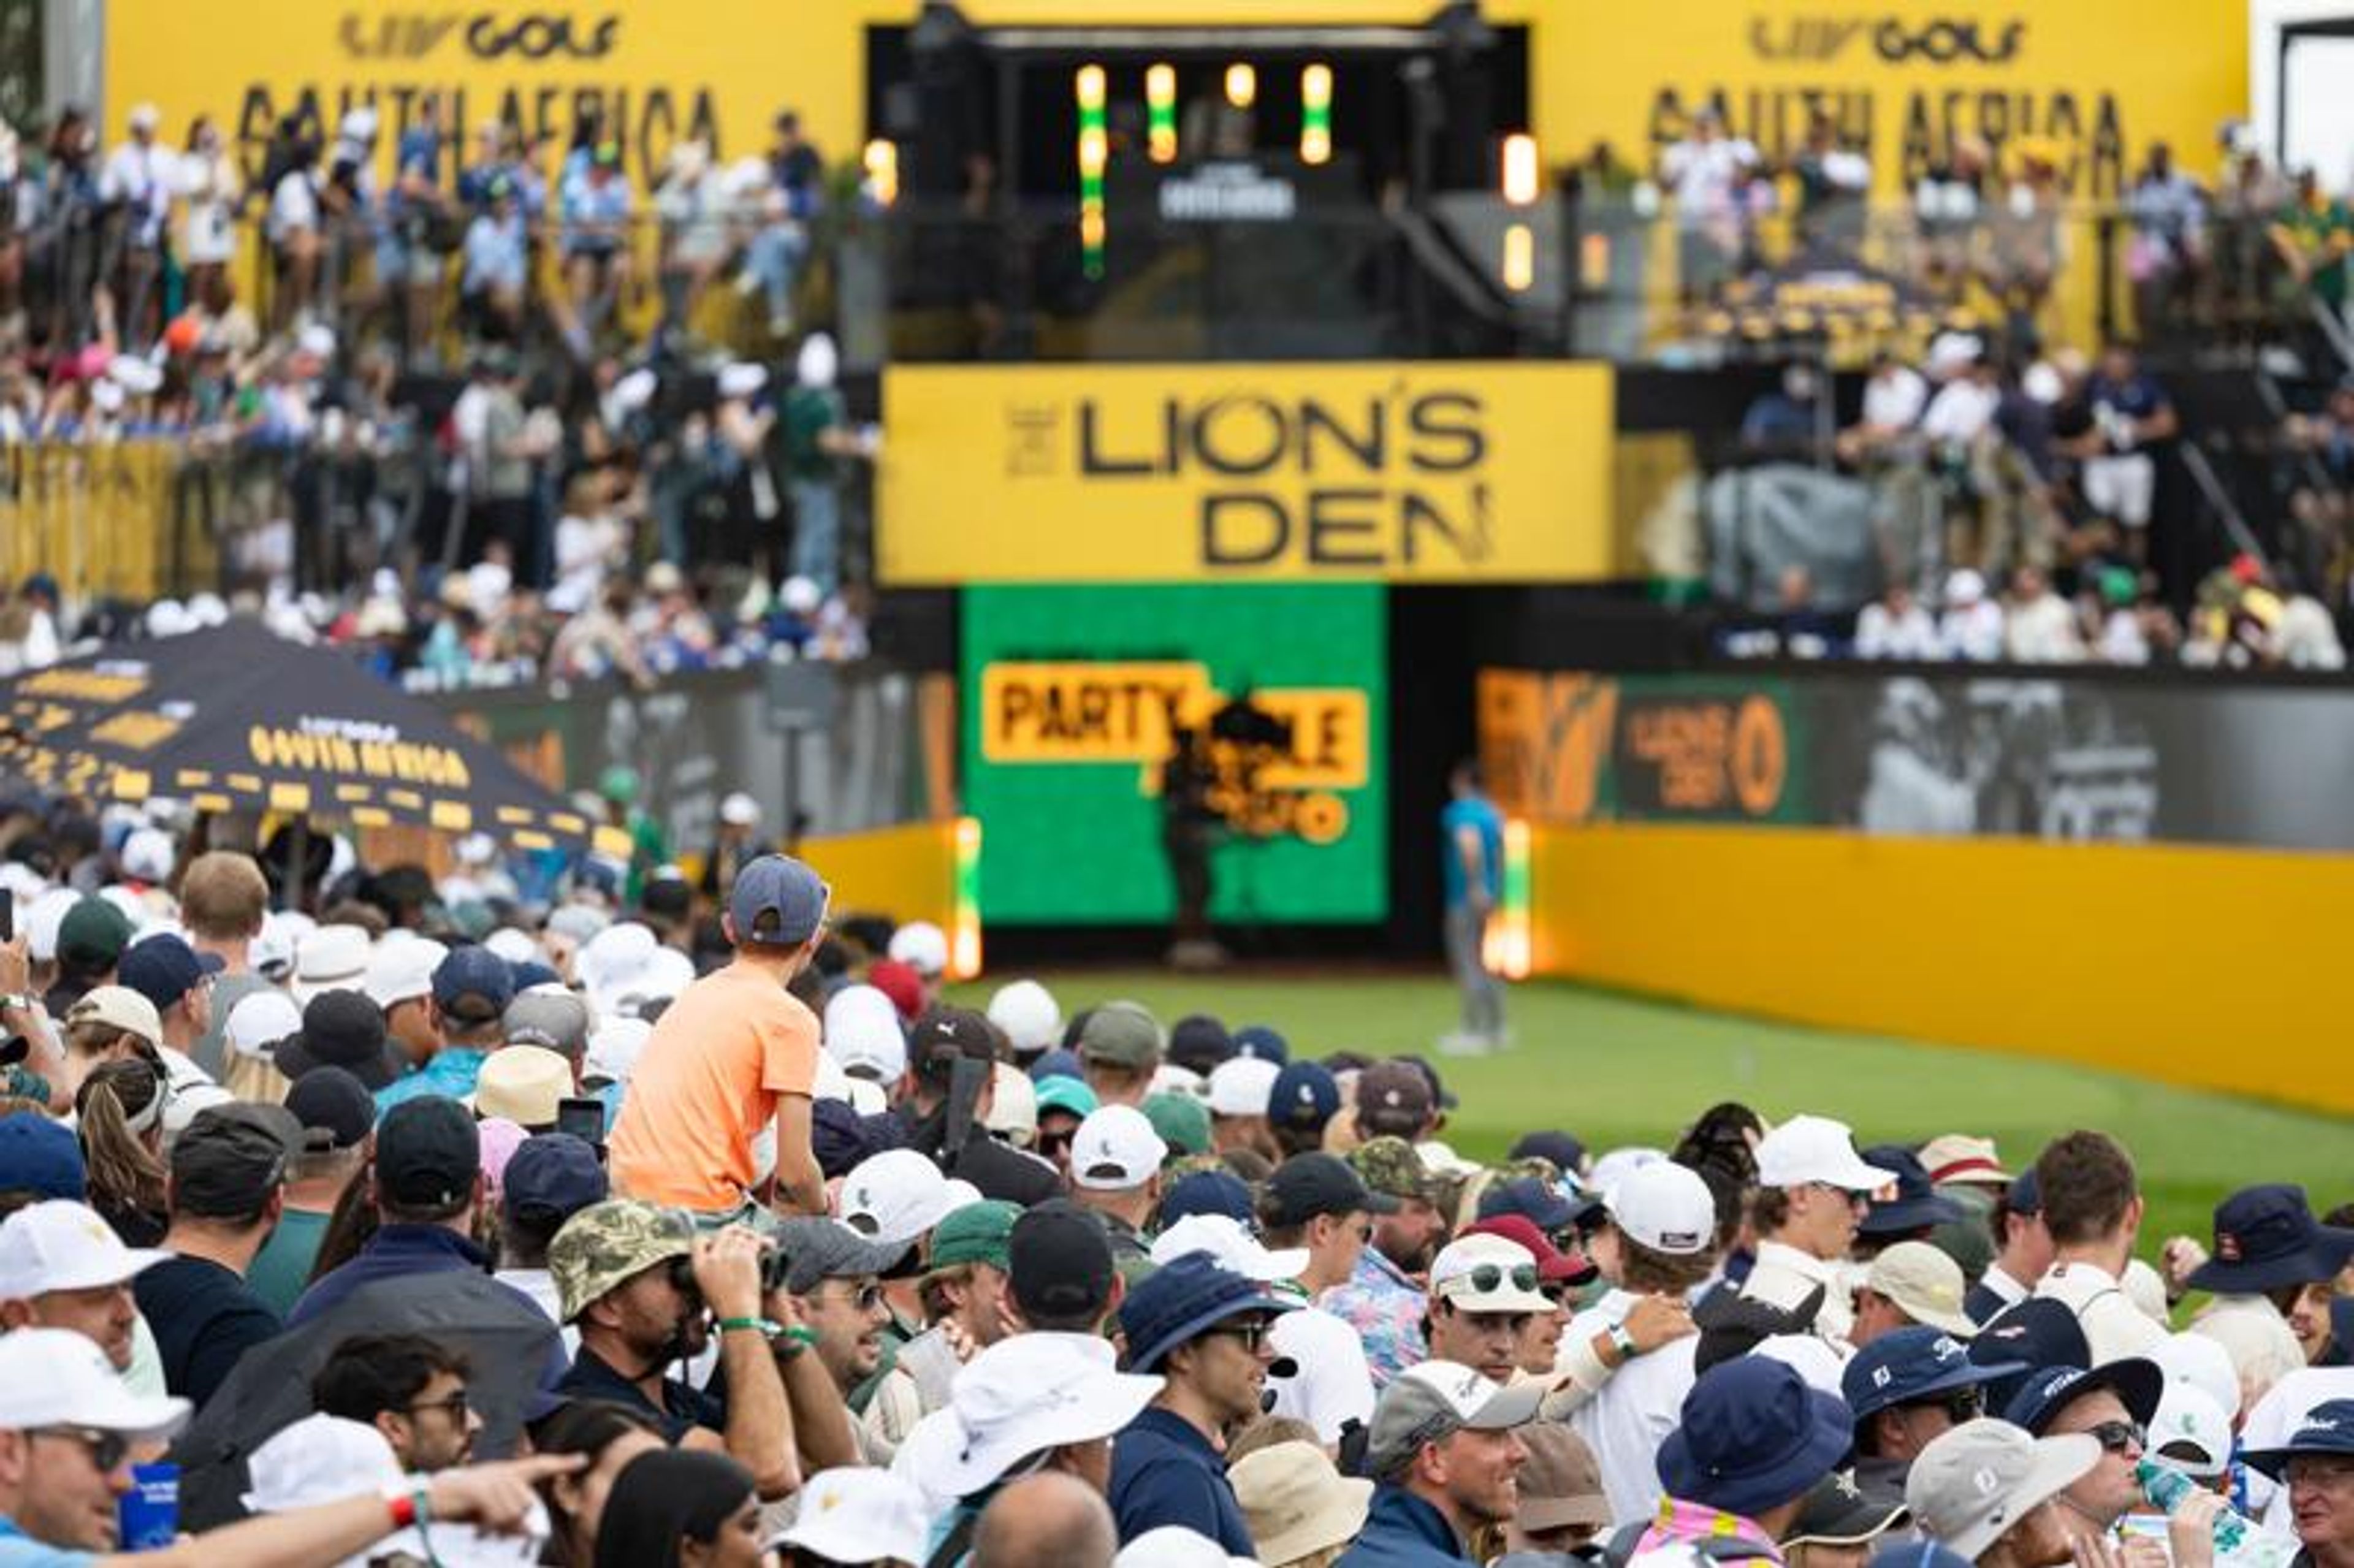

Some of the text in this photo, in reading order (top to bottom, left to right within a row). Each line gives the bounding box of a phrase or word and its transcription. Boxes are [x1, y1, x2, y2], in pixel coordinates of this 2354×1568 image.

[466, 15, 619, 58] GOLF
[1873, 18, 2022, 63] GOLF
[1081, 380, 1487, 475] LION'S
[1202, 488, 1488, 565] DEN
[1001, 682, 1186, 743] PARTY
